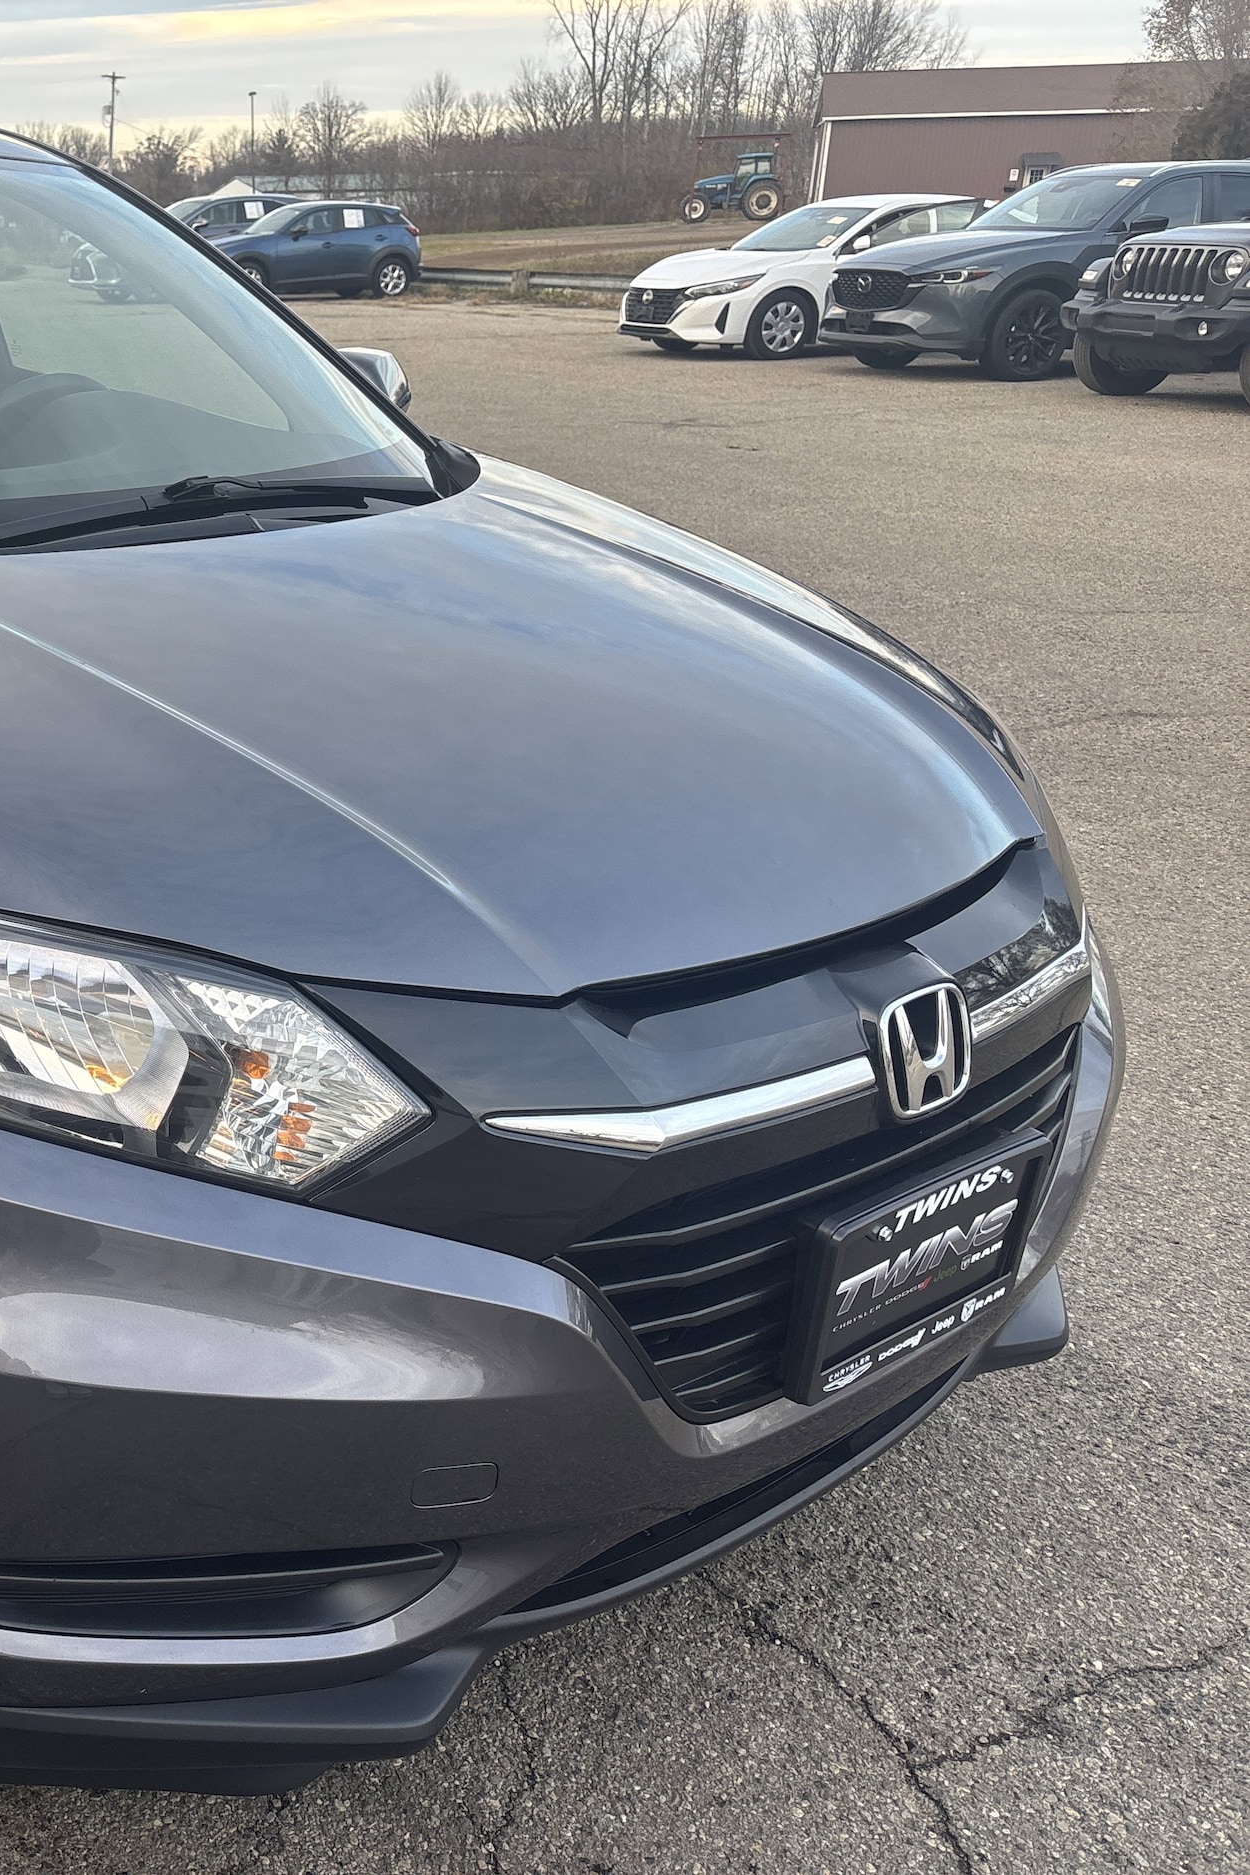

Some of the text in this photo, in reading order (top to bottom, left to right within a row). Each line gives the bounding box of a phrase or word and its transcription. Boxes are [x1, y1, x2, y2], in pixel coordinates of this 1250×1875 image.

[893, 1165, 1002, 1234] TWINS
[832, 1240, 1004, 1333] CHRYSLER DODGE Jeep RAM
[836, 1198, 1019, 1317] TWINS
[828, 1354, 872, 1382] CHRYSLER
[931, 1314, 956, 1335] Jeep
[974, 1287, 1006, 1311] RAM
